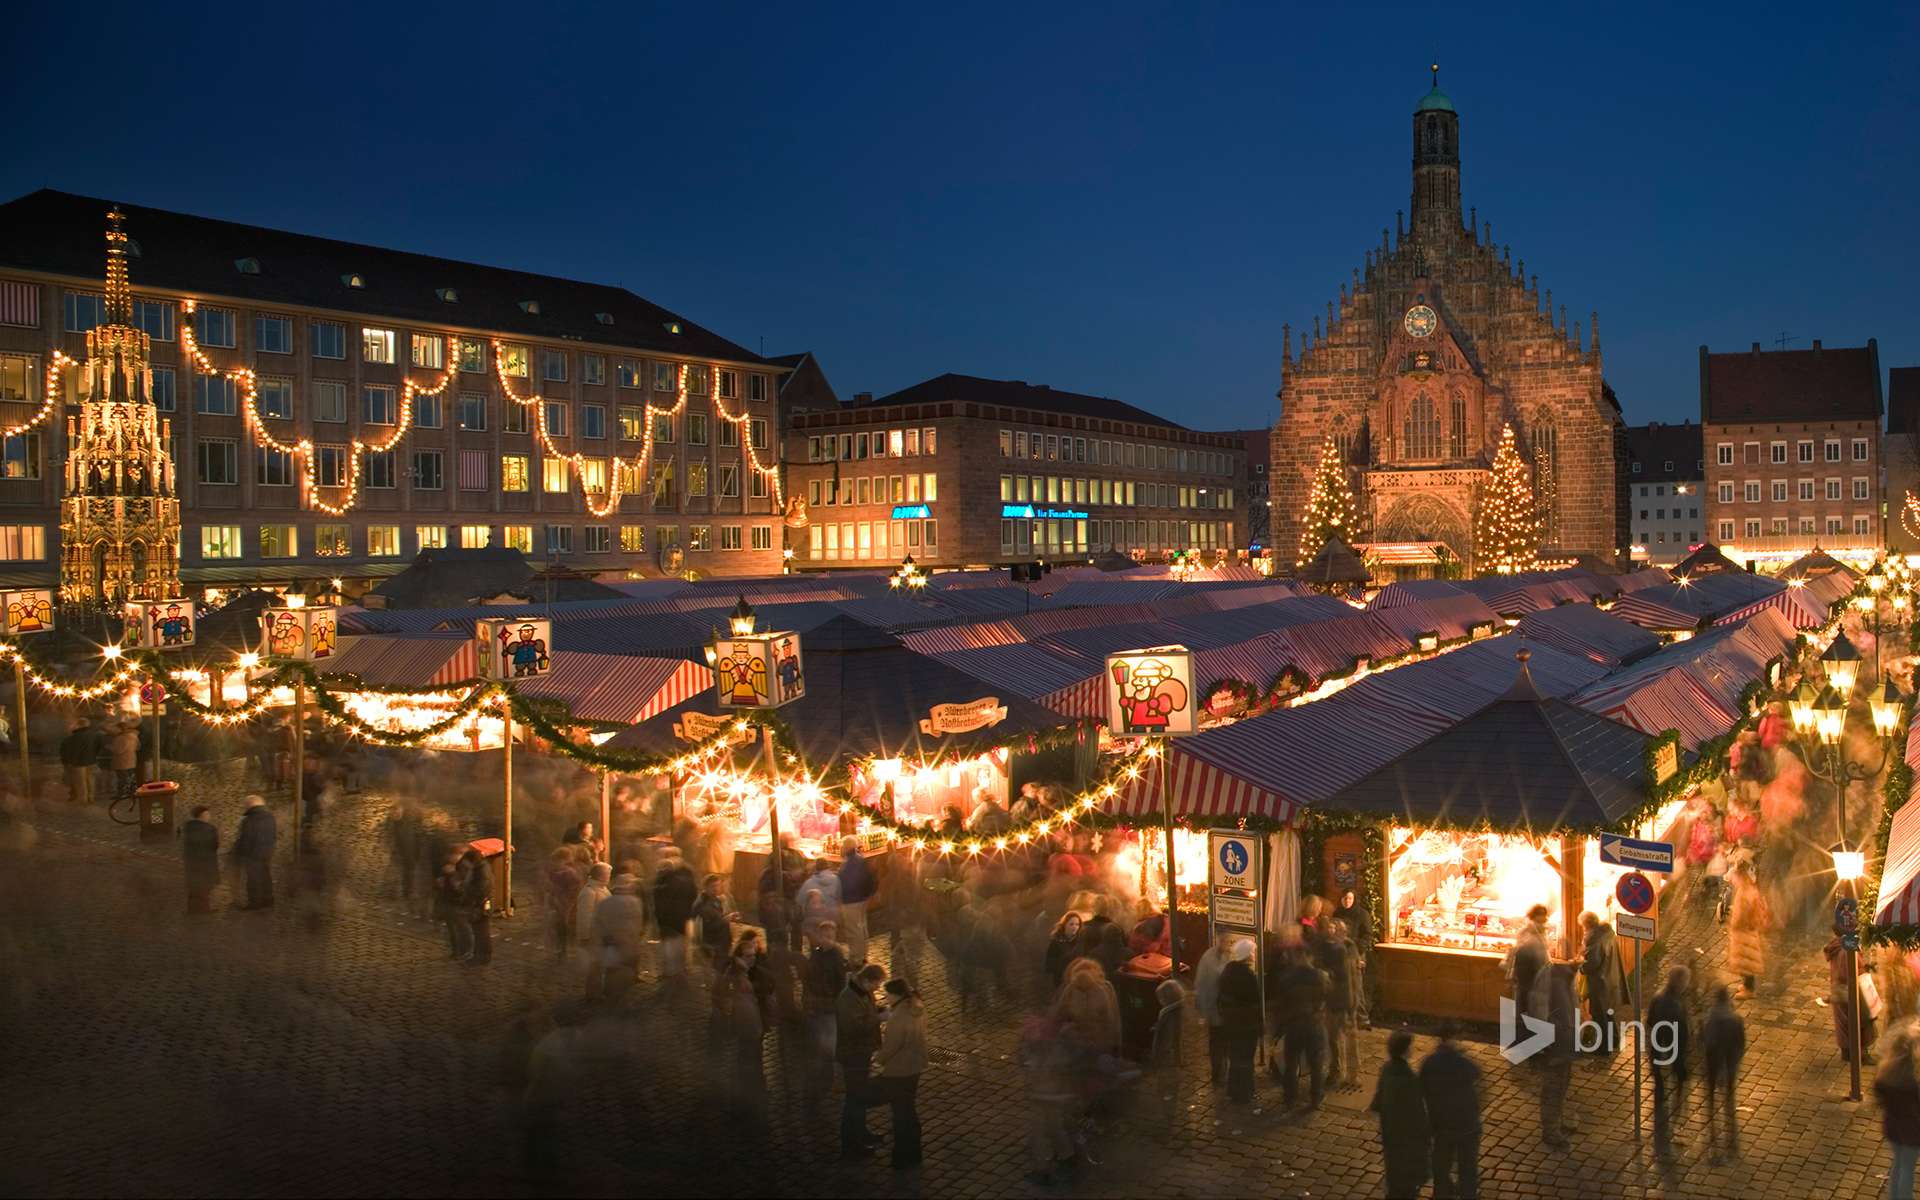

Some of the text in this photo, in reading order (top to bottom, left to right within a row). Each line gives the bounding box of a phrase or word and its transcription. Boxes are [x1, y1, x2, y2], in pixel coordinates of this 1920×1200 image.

[1619, 847, 1669, 861] Einbahnstraße
[1223, 875, 1246, 886] ZONE
[1618, 920, 1653, 935] Rettungsweg
